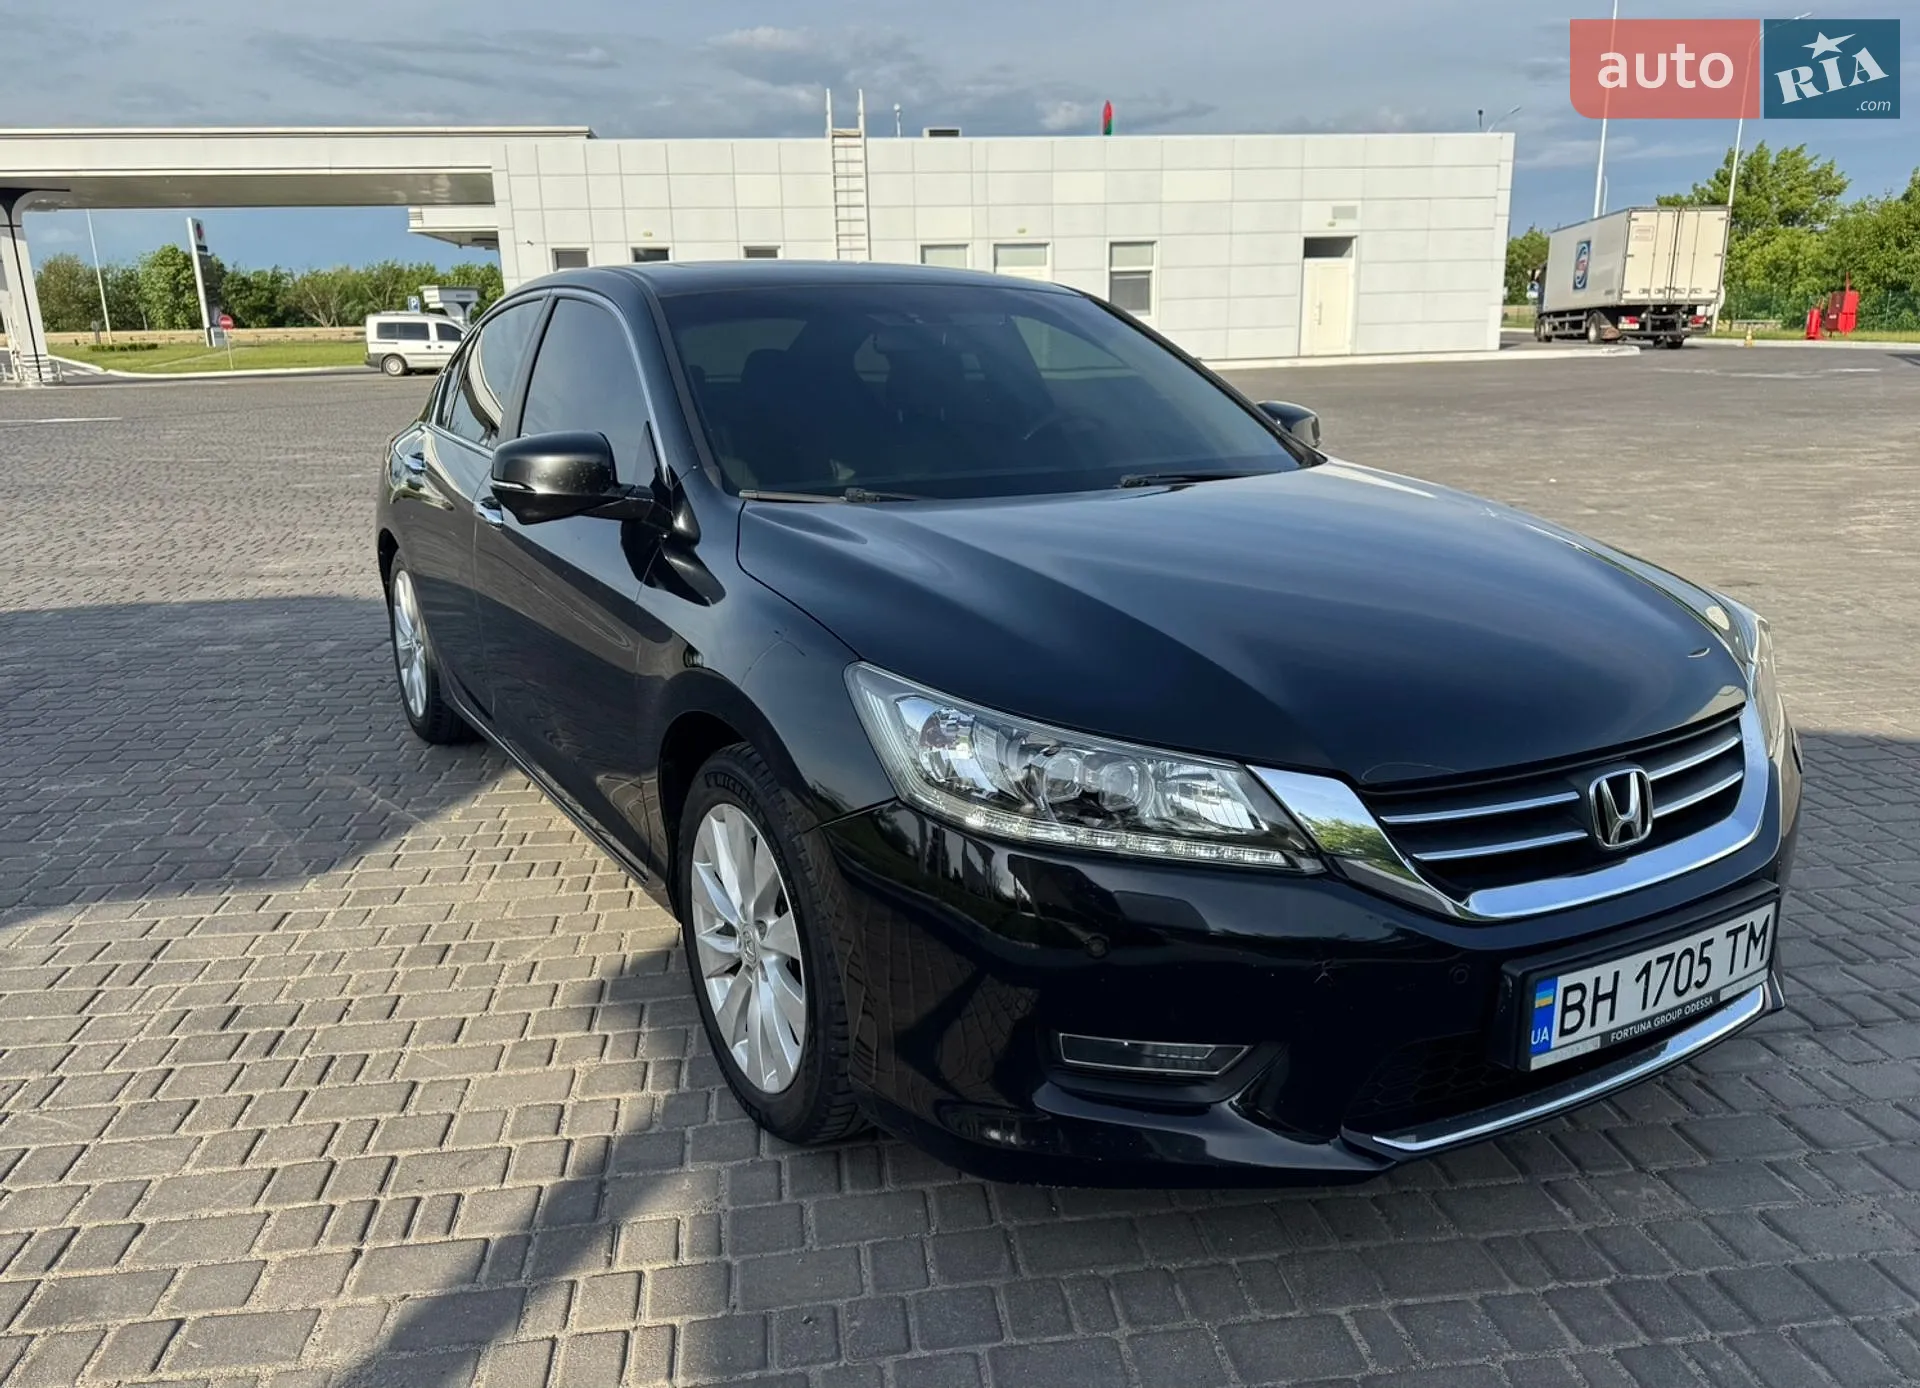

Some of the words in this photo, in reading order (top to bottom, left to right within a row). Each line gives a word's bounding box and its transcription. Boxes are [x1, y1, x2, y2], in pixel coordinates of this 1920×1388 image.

[1559, 969, 1620, 1038] BH
[1634, 937, 1715, 1011] 1705
[1725, 913, 1771, 976] TM
[1530, 1025, 1550, 1045] UA
[1610, 1019, 1652, 1043] FORTUNA
[1653, 1009, 1682, 1028] GROUP
[1684, 996, 1714, 1016] ODESSA
